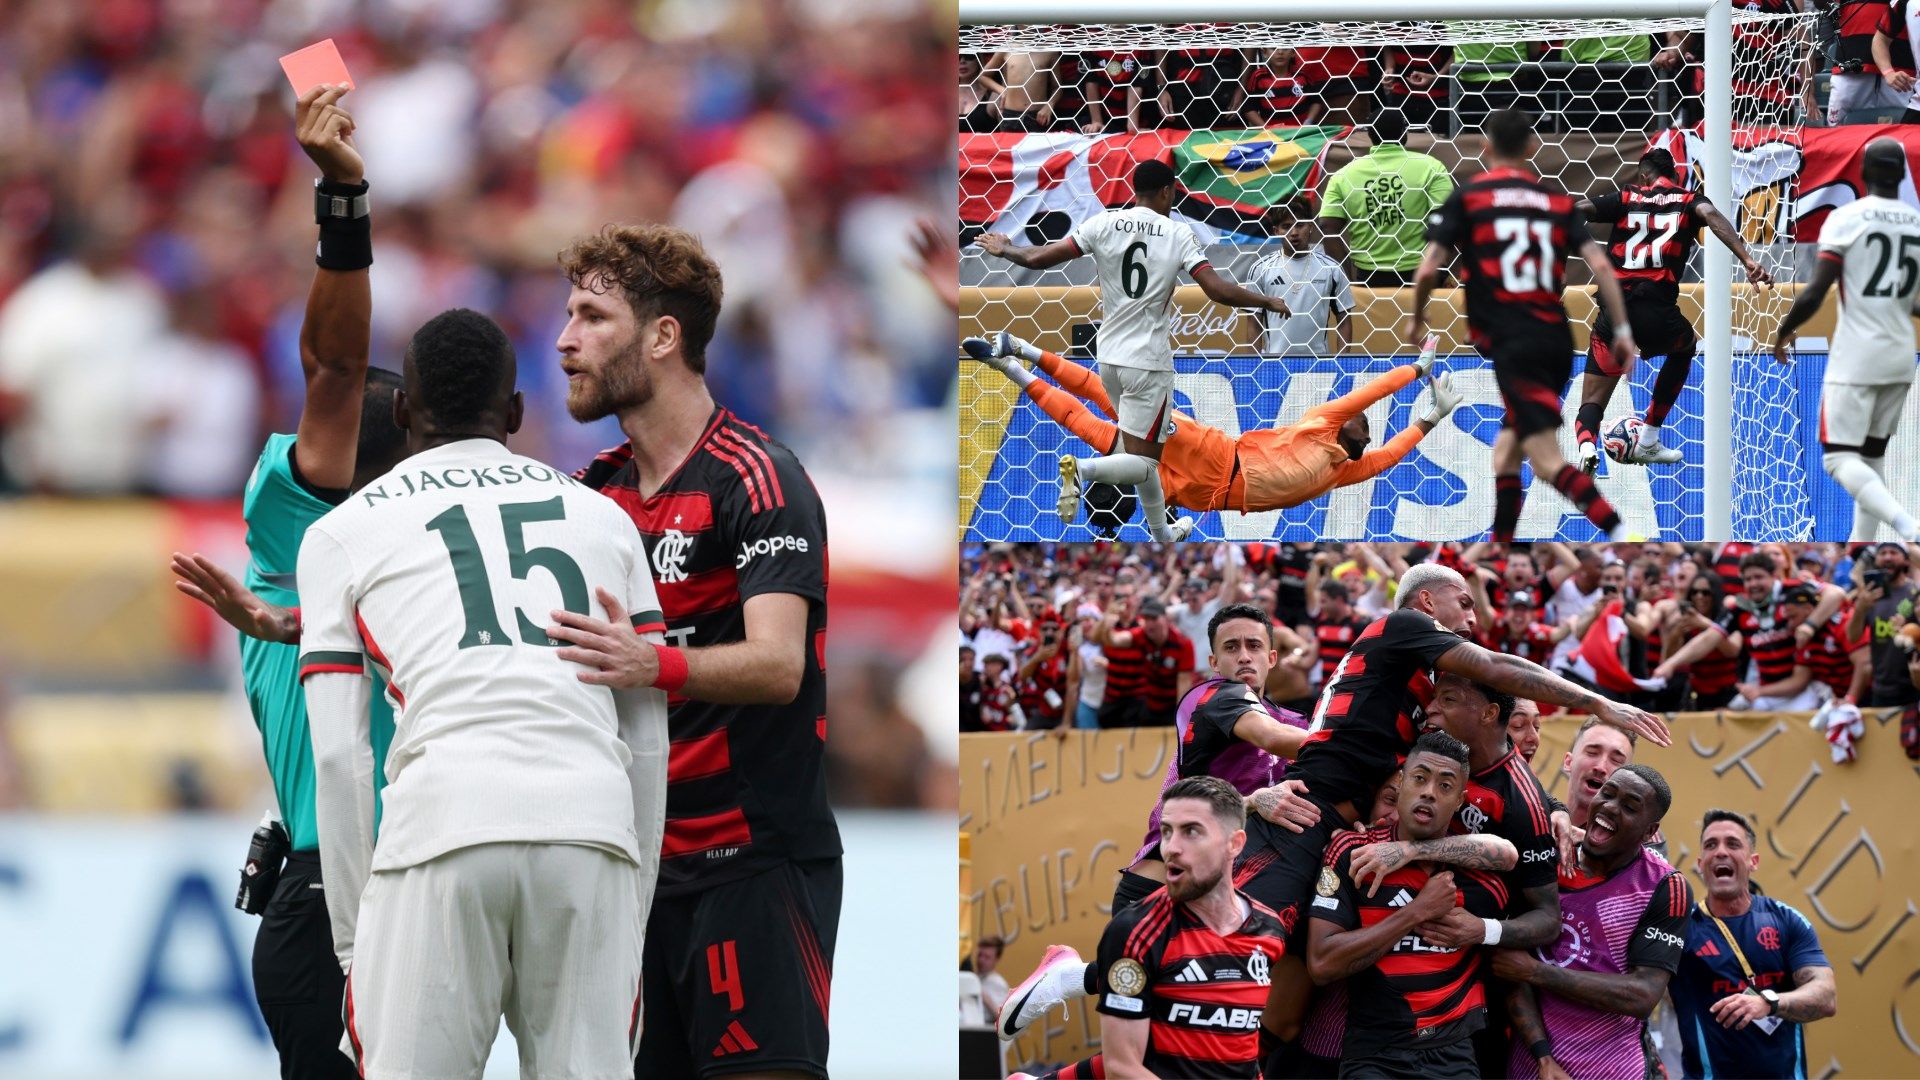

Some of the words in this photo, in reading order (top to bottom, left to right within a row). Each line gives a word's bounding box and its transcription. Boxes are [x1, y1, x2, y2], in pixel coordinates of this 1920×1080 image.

[1364, 175, 1403, 195] CSC
[1121, 241, 1148, 300] 6
[1493, 217, 1556, 294] 21
[1622, 211, 1681, 269] 27
[1862, 231, 1920, 299] 25
[1170, 370, 1663, 543] VISA
[425, 495, 591, 650] 15
[706, 940, 745, 1012] 4
